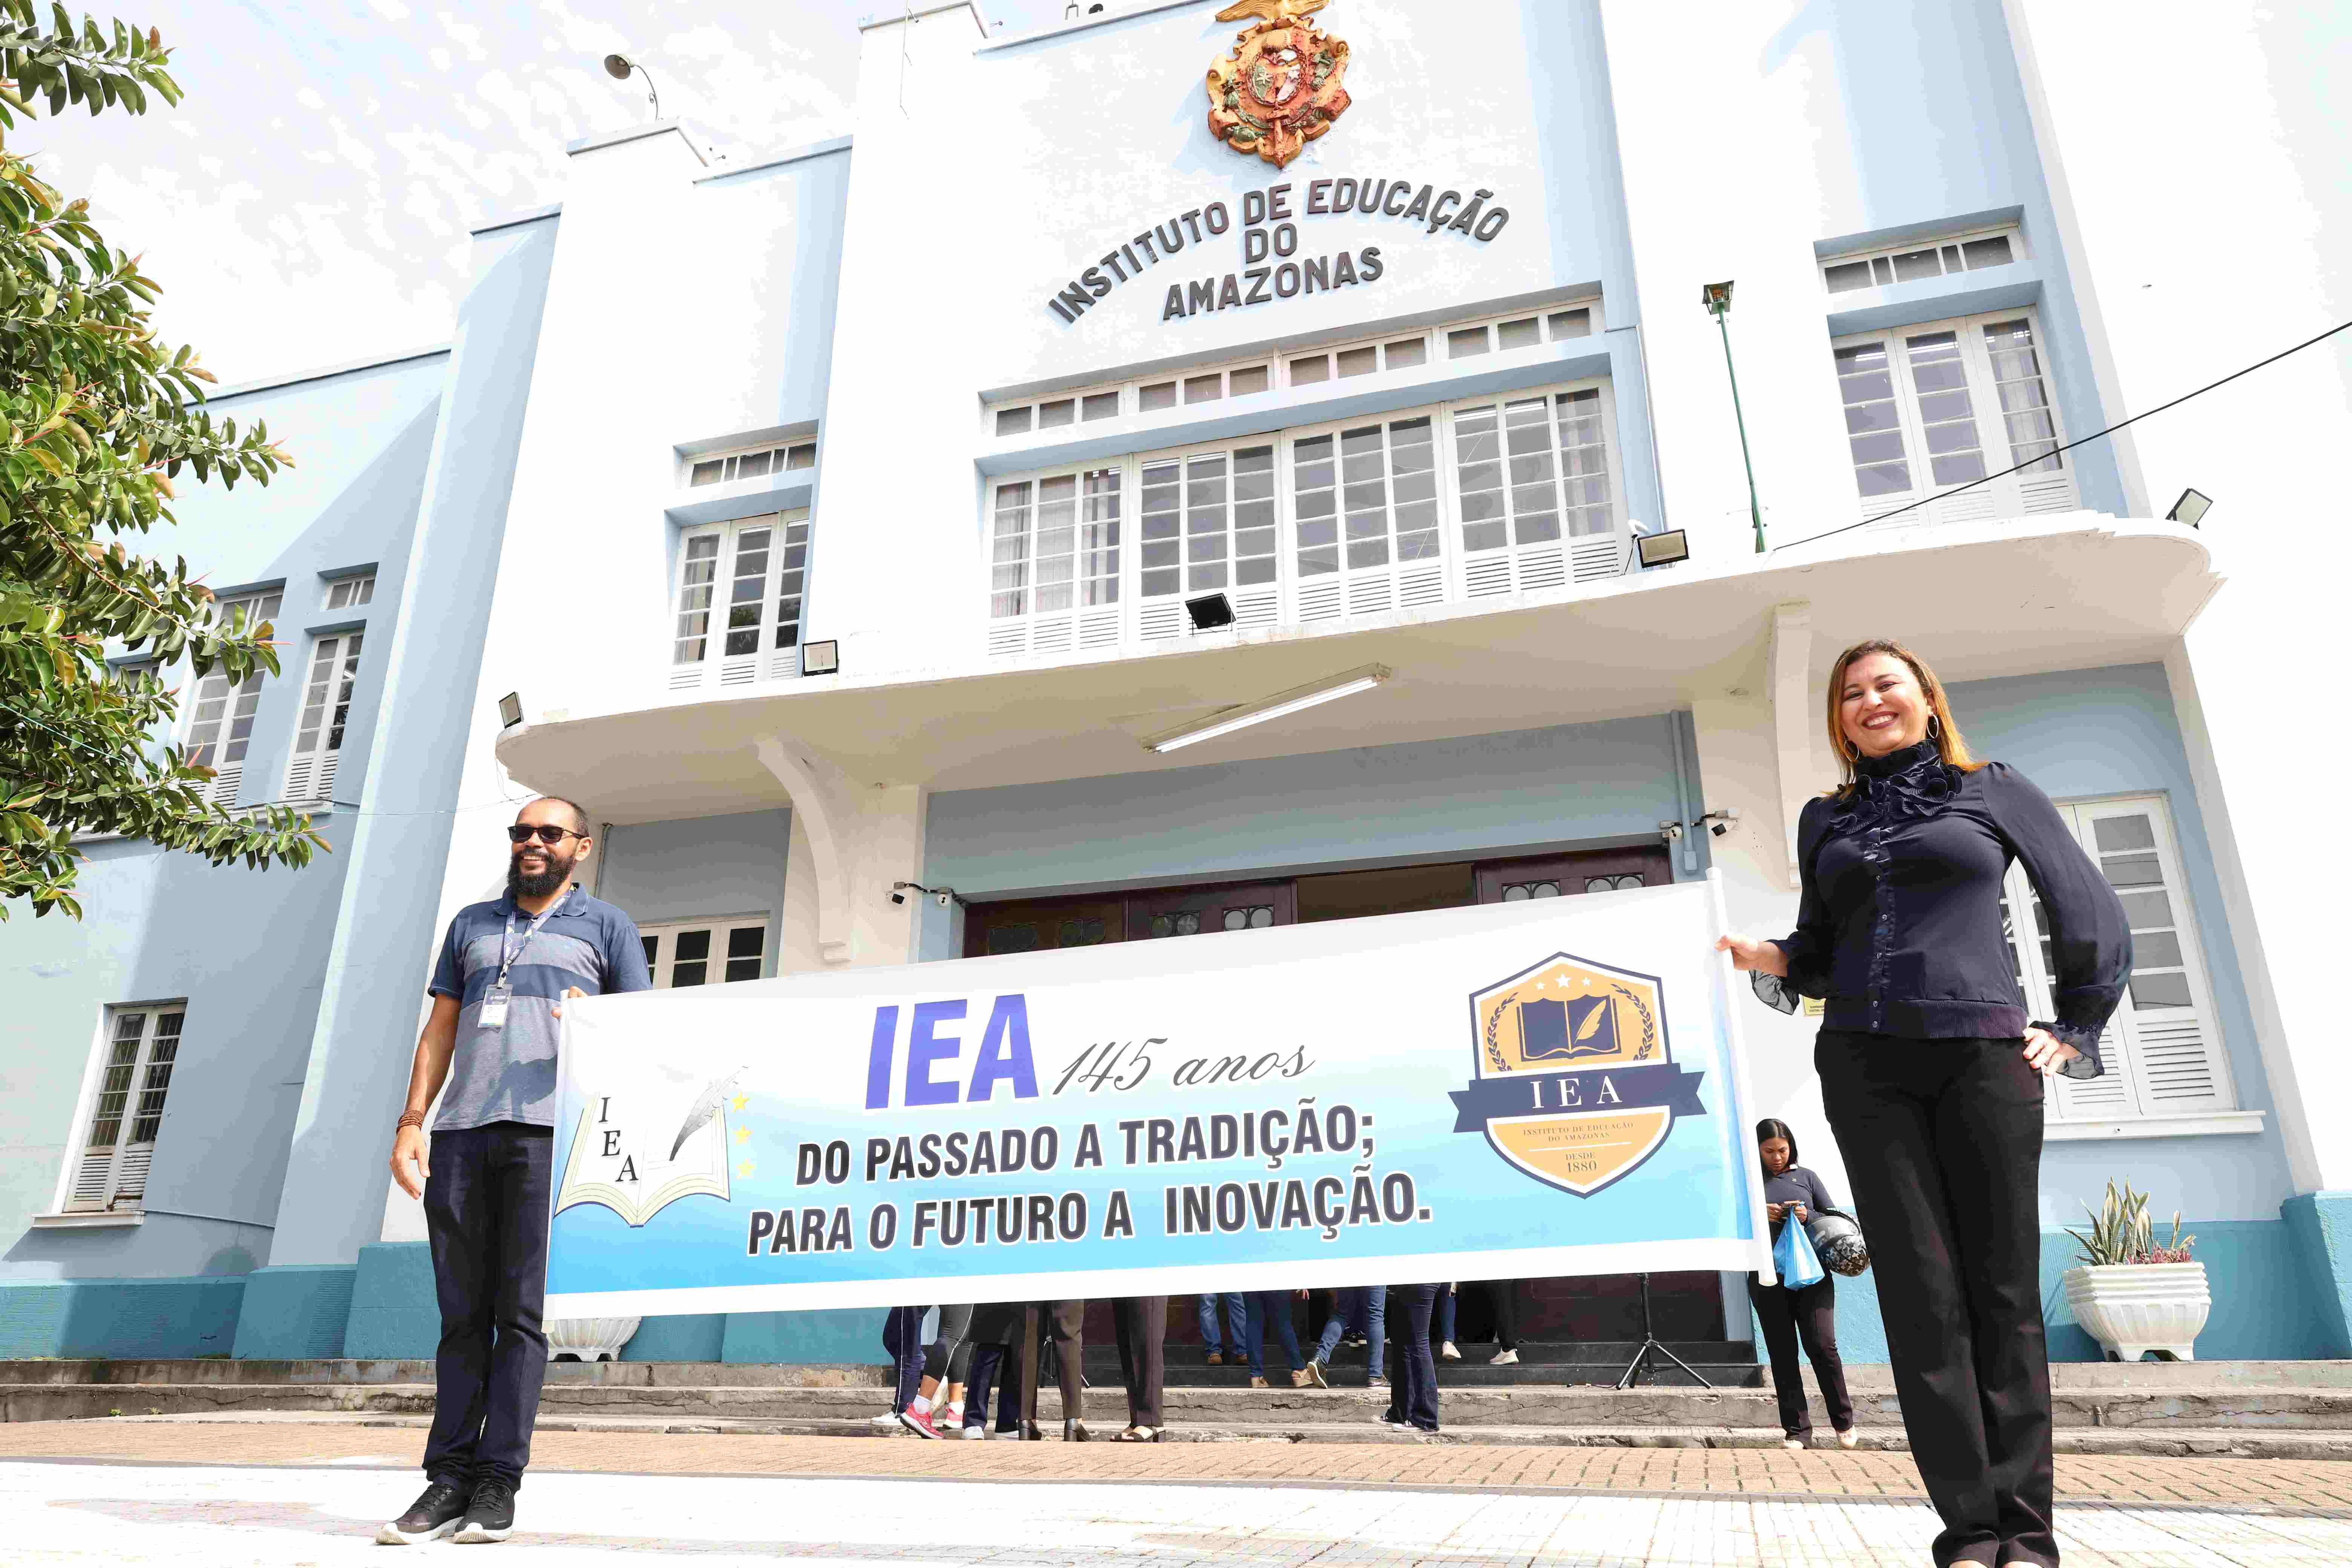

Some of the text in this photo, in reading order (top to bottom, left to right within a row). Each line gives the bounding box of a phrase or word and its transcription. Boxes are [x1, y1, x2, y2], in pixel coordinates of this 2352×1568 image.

[1049, 178, 1509, 323] INSTITUTO DE EDUCAÇÃO
[1245, 223, 1297, 263] DO
[1164, 247, 1384, 320] AMAZONAS
[865, 994, 1315, 1110] IEA 145 anos
[796, 1096, 1373, 1185] DO PASSADO A TRADIÇÃO;
[1523, 1126, 1569, 1136] INSTITUTO
[1565, 1132, 1610, 1140] AMAZONAS
[1565, 1152, 1596, 1160] DESDE
[1567, 1161, 1597, 1173] 1880
[748, 1164, 1430, 1254] PARA O FUTURO A INOVAÇÃO.
